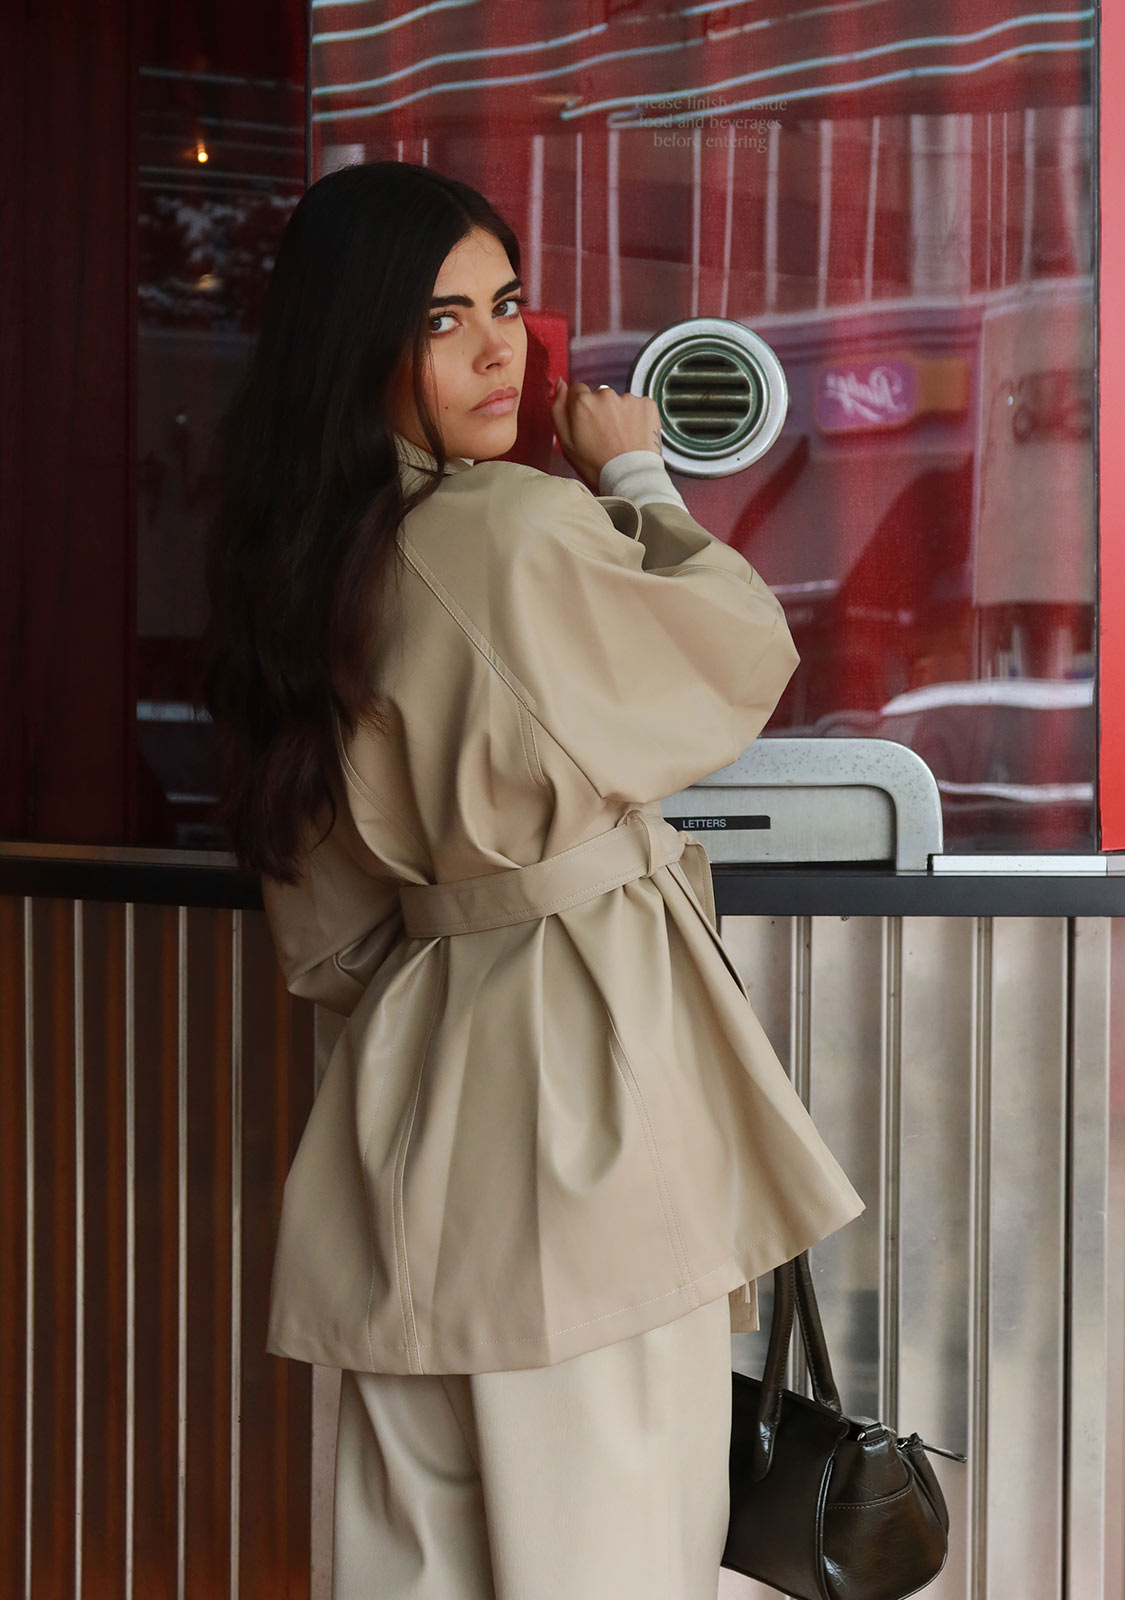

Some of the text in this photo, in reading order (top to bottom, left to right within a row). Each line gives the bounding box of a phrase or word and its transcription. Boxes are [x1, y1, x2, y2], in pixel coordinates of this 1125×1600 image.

[687, 95, 727, 109] finish
[638, 113, 782, 135] food and beverages
[706, 134, 767, 153] entering
[682, 819, 727, 829] LETTERS
